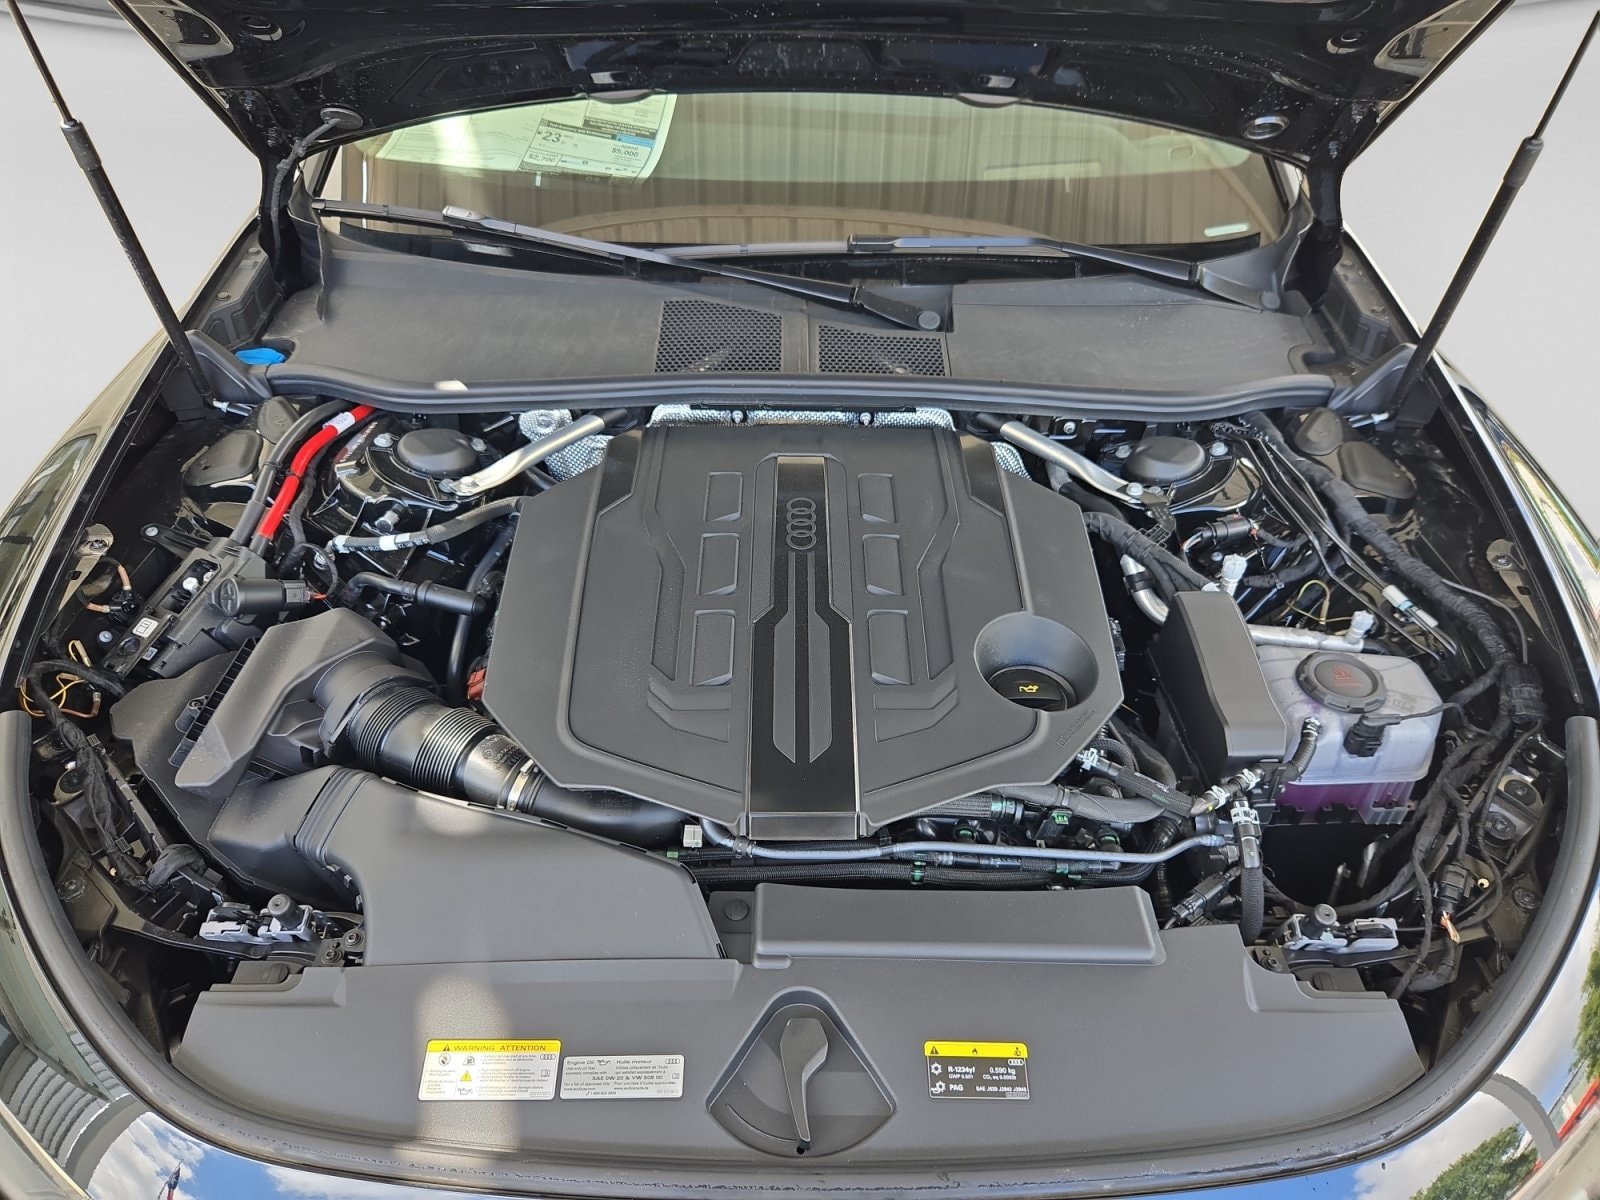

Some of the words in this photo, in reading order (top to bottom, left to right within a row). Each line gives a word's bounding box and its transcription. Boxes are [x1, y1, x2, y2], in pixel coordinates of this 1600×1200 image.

[542, 131, 562, 143] 23
[611, 147, 639, 158] $5,000
[528, 153, 557, 164] $2,700
[453, 1044, 495, 1052] WARNING
[499, 1044, 547, 1052] ATTENTION
[947, 1065, 976, 1074] R-1234yf
[989, 1066, 1007, 1074] 0.590
[1007, 1066, 1016, 1075] kg
[949, 1083, 964, 1092] PAG
